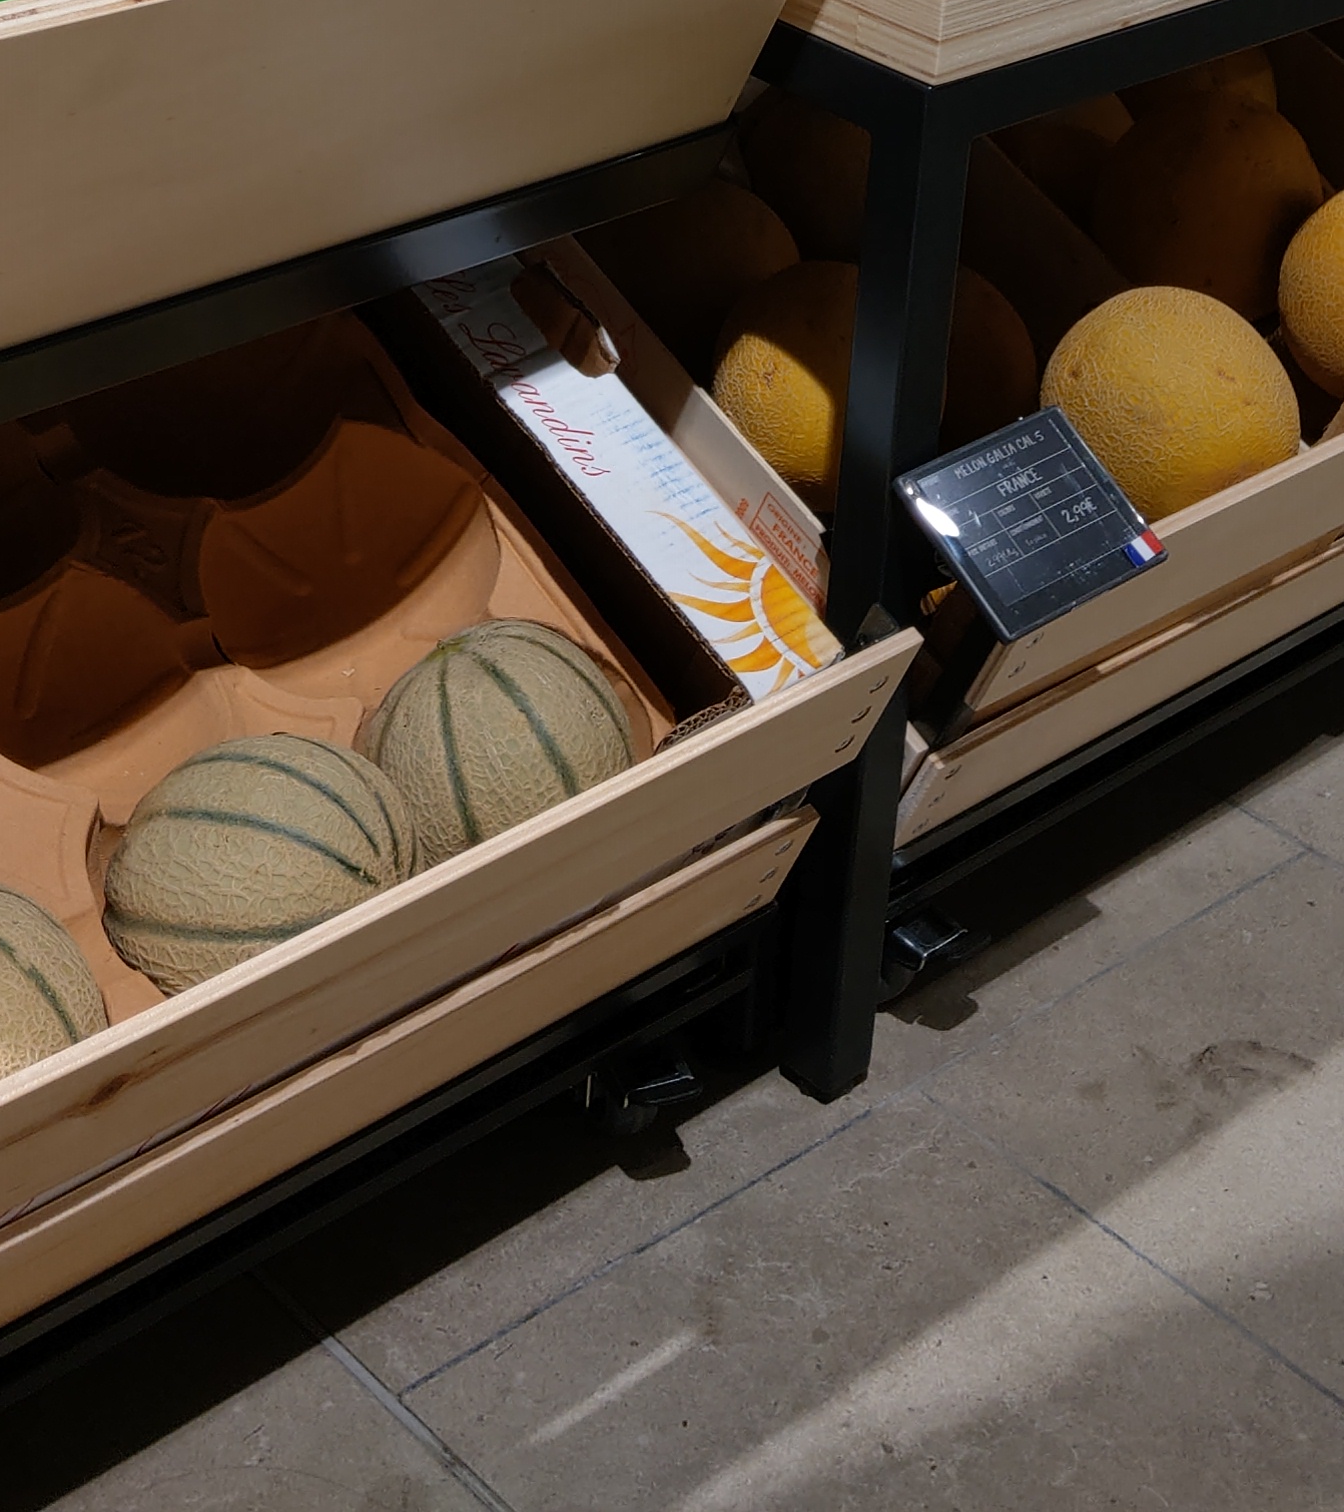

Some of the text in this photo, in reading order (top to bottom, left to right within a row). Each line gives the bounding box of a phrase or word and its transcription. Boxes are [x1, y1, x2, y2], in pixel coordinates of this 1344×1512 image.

[459, 322, 612, 479] Lavandins
[954, 457, 987, 479] MELON
[986, 443, 1017, 464] GALIA
[1016, 434, 1037, 450] CAL
[996, 467, 1043, 497] FRANCE
[772, 523, 820, 578] FRANCE
